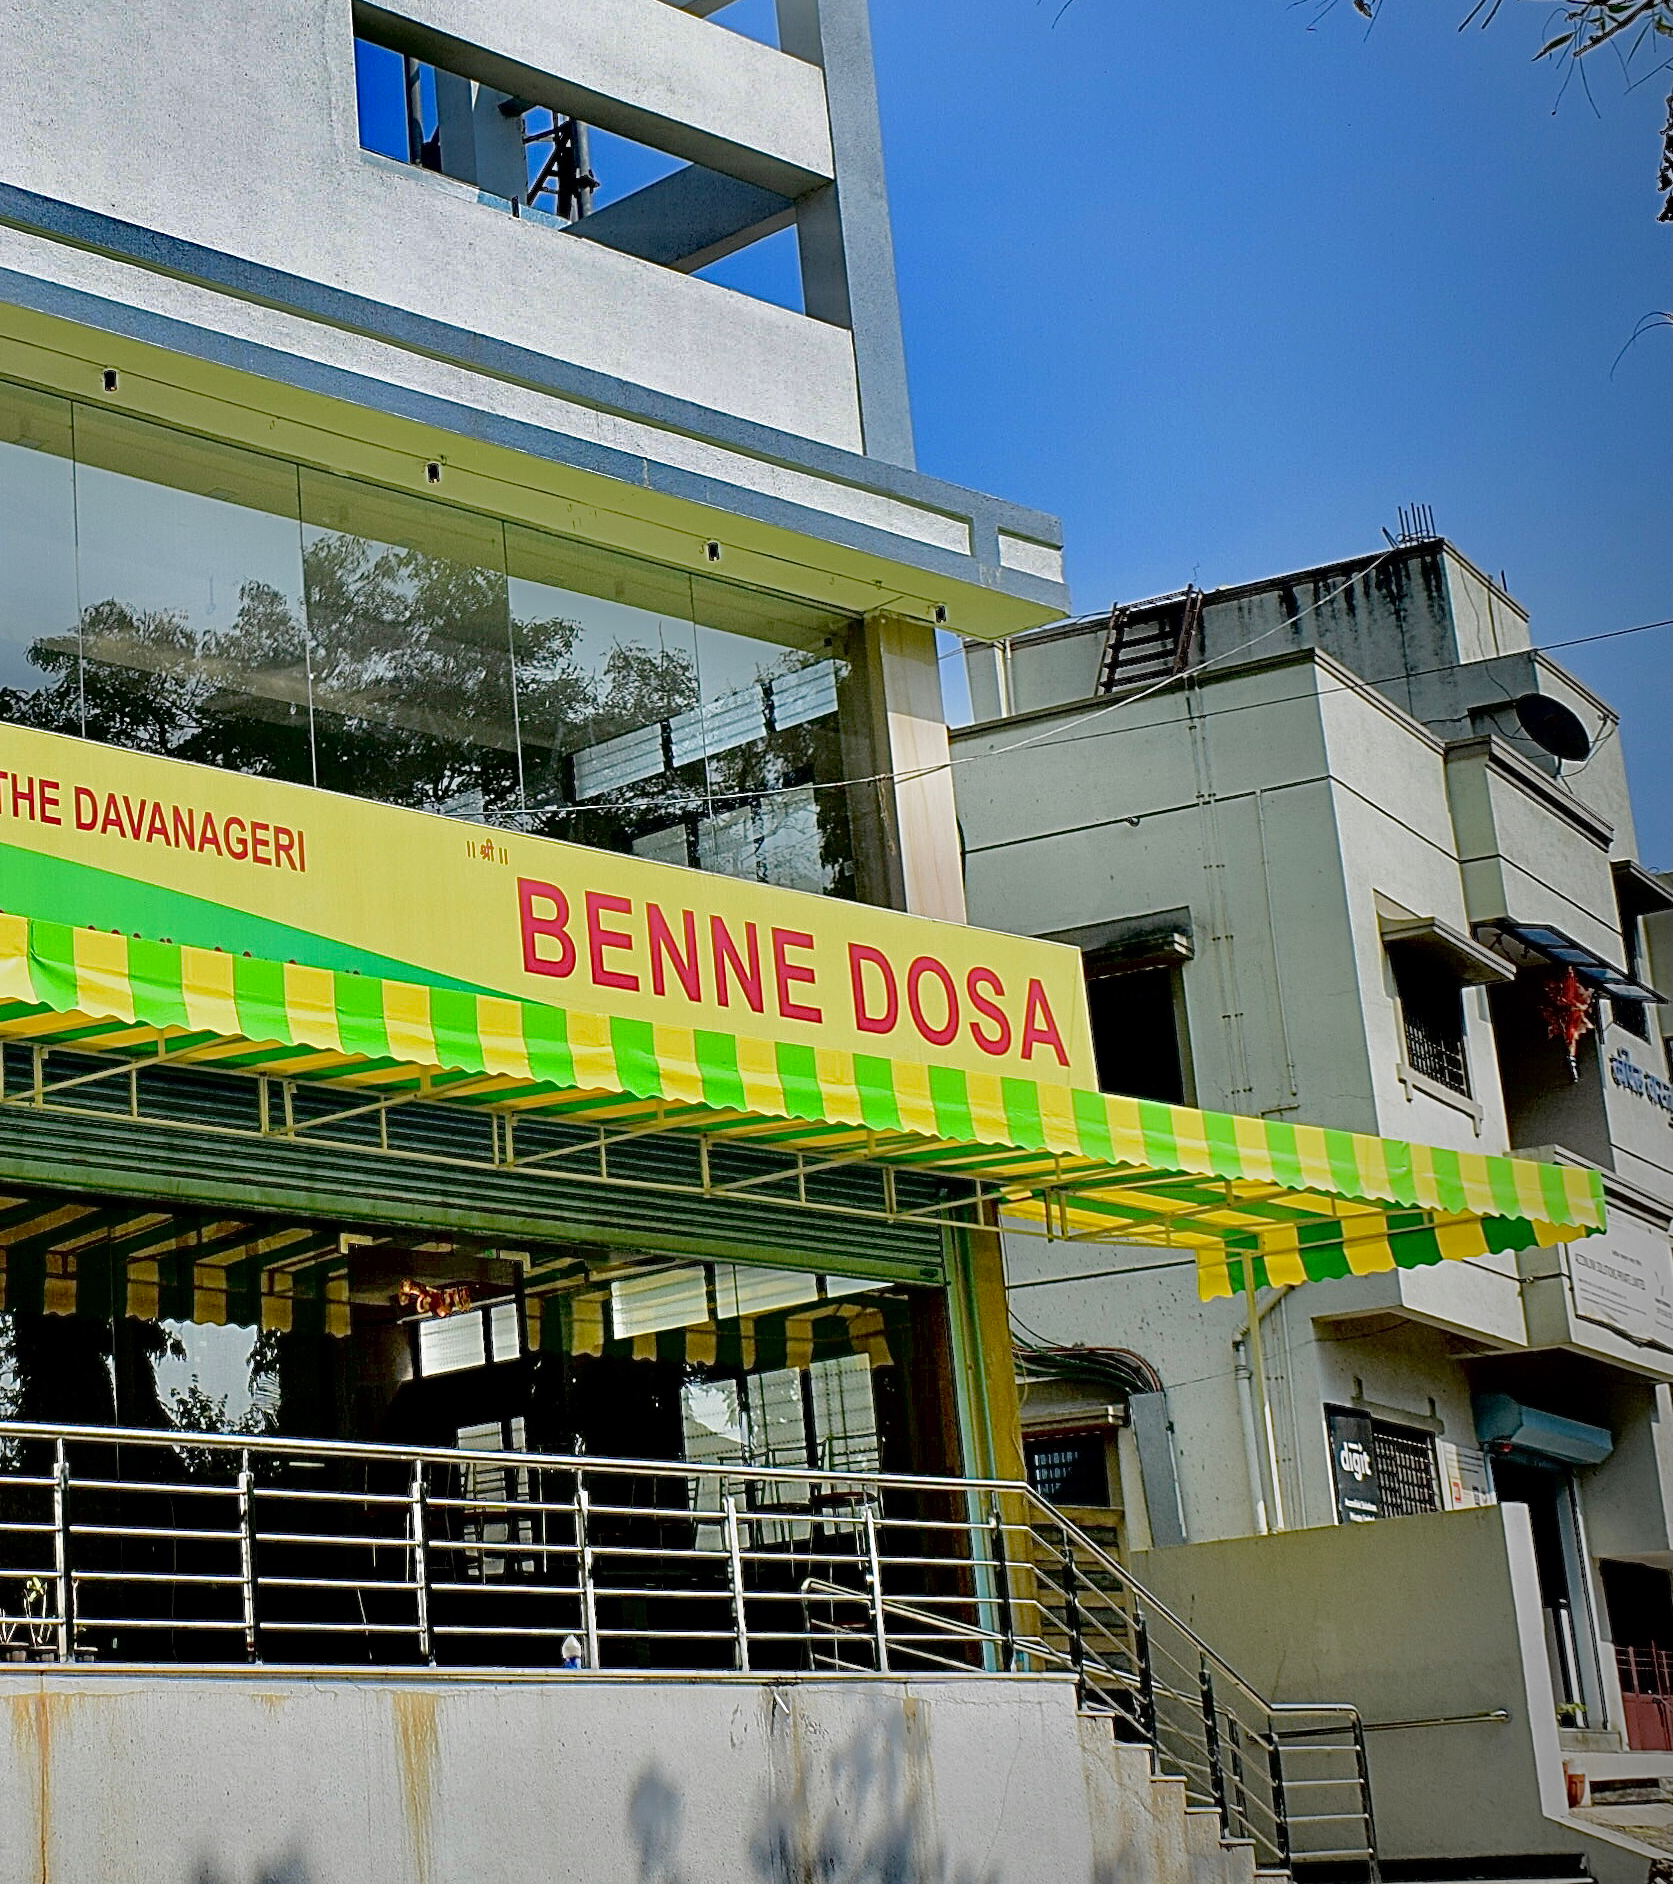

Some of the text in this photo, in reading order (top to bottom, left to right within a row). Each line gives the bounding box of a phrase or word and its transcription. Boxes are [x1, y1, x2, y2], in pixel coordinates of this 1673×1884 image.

[74, 785, 307, 873] DAVANAGERI
[516, 876, 1071, 1068] BENNE DOSA
